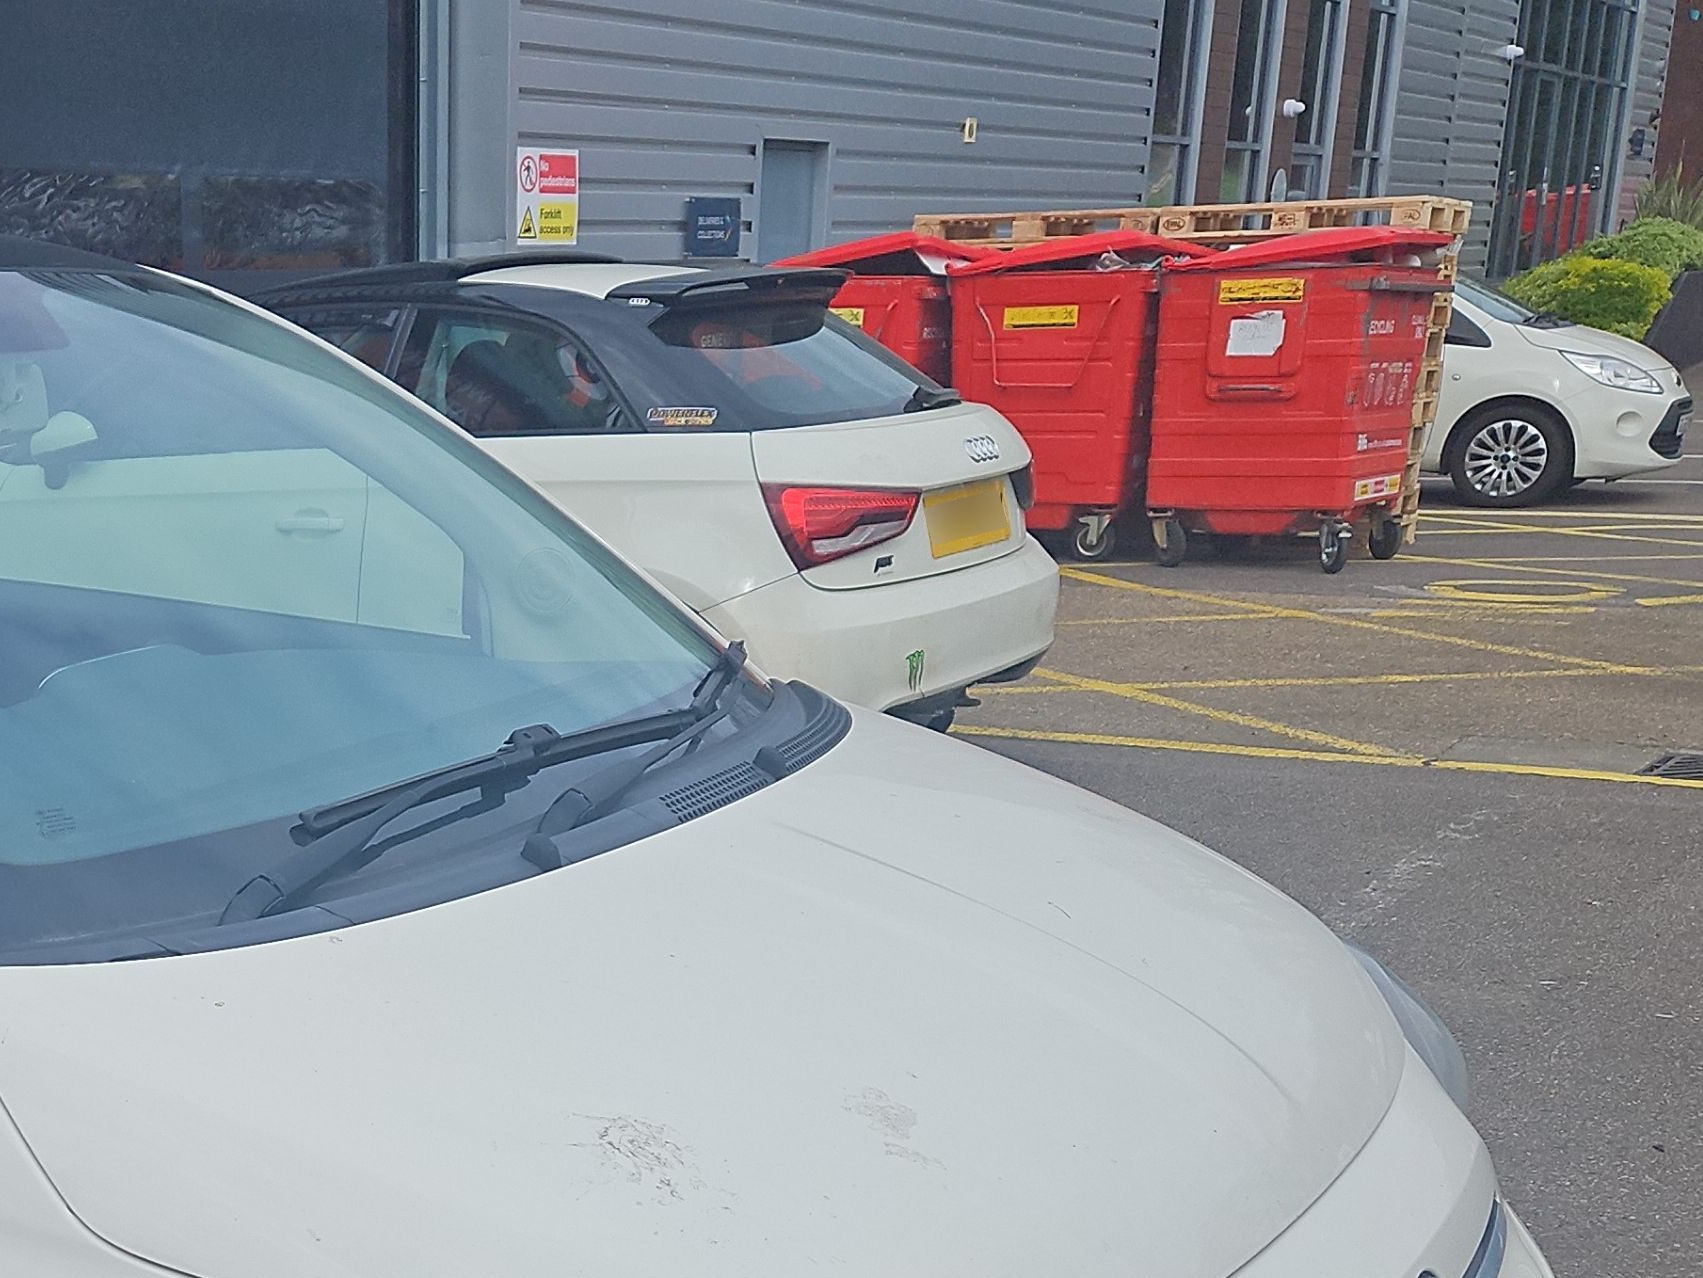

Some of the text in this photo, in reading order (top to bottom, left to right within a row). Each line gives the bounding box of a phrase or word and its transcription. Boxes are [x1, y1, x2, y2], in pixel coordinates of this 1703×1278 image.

[540, 175, 576, 189] pedestrians
[540, 207, 562, 219] Forklift
[539, 224, 574, 237] access only
